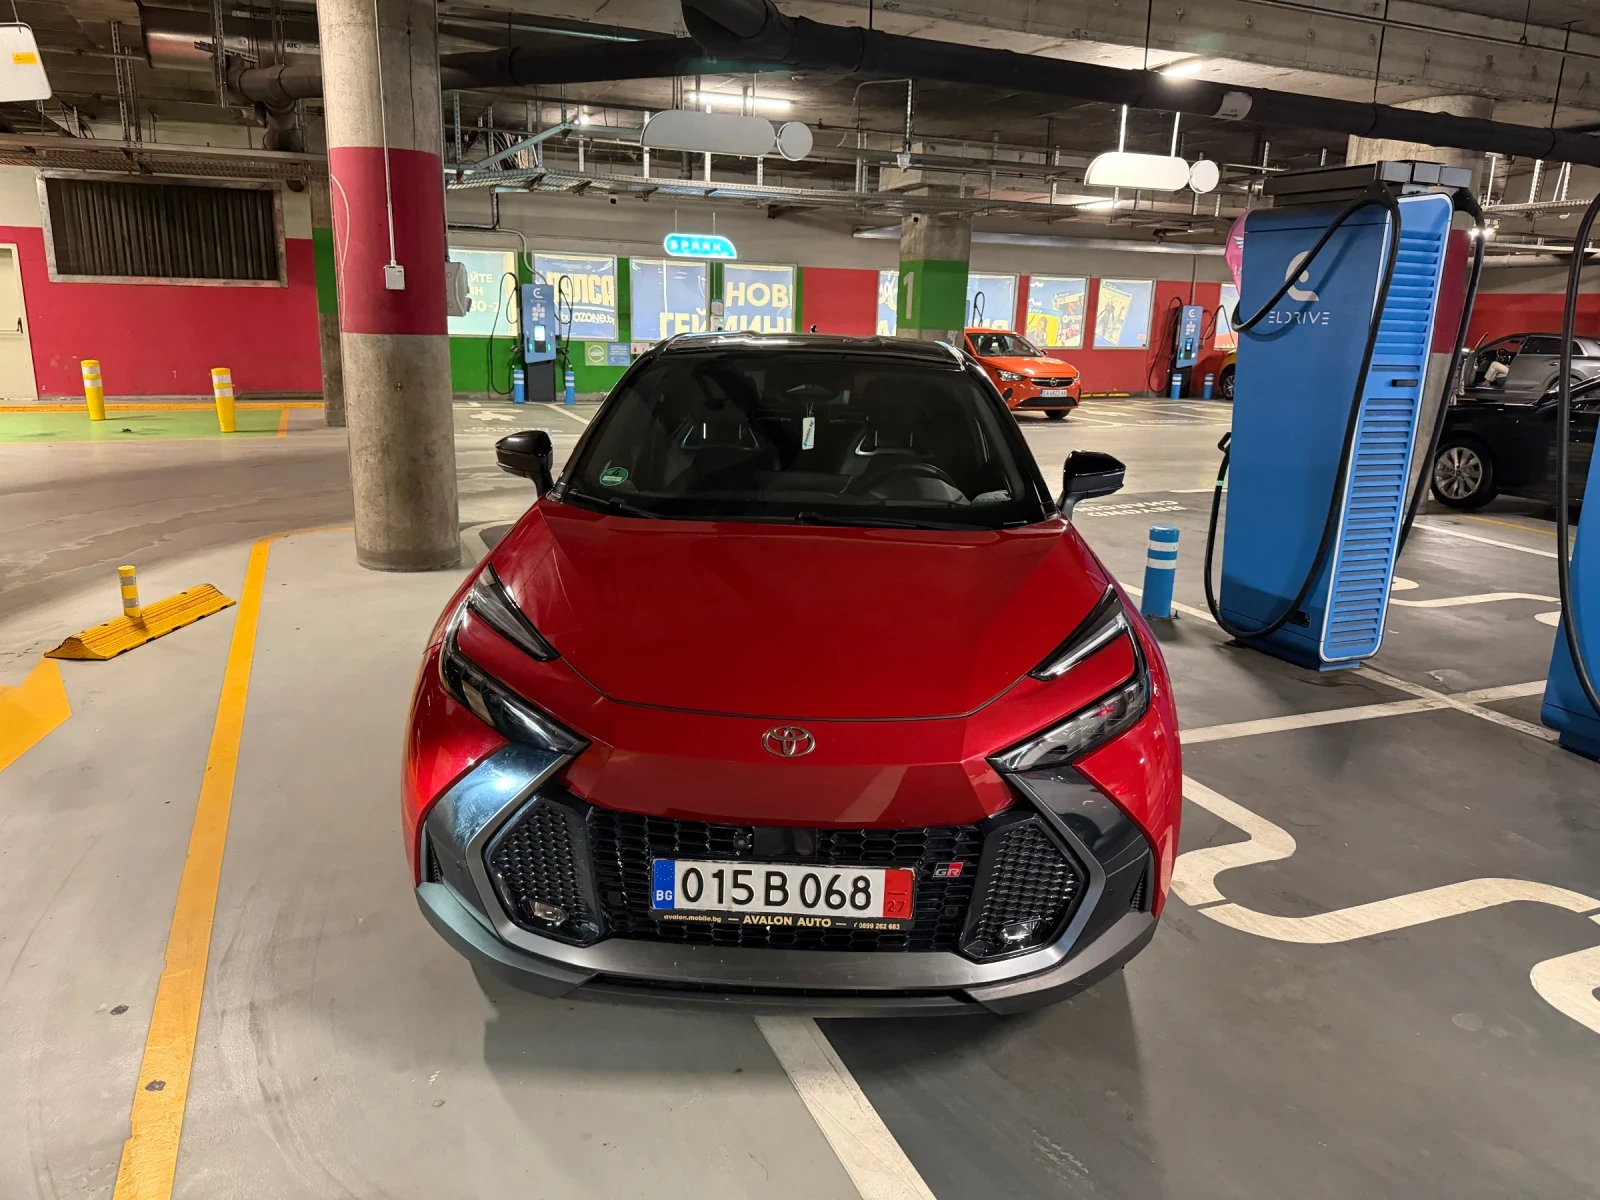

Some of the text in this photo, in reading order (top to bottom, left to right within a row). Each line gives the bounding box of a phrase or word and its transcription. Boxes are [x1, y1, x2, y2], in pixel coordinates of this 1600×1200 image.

[669, 239, 721, 251] SPARK
[468, 271, 494, 283] ЙТЕ
[725, 282, 793, 308] НОВ
[903, 271, 915, 320] 1
[1268, 310, 1331, 325] ELDRIVE
[935, 868, 960, 876] GR
[656, 890, 673, 901] BG
[887, 900, 907, 912] 27
[663, 914, 722, 923] avalon.mobile.bg
[742, 915, 832, 928] AVALON AUTO
